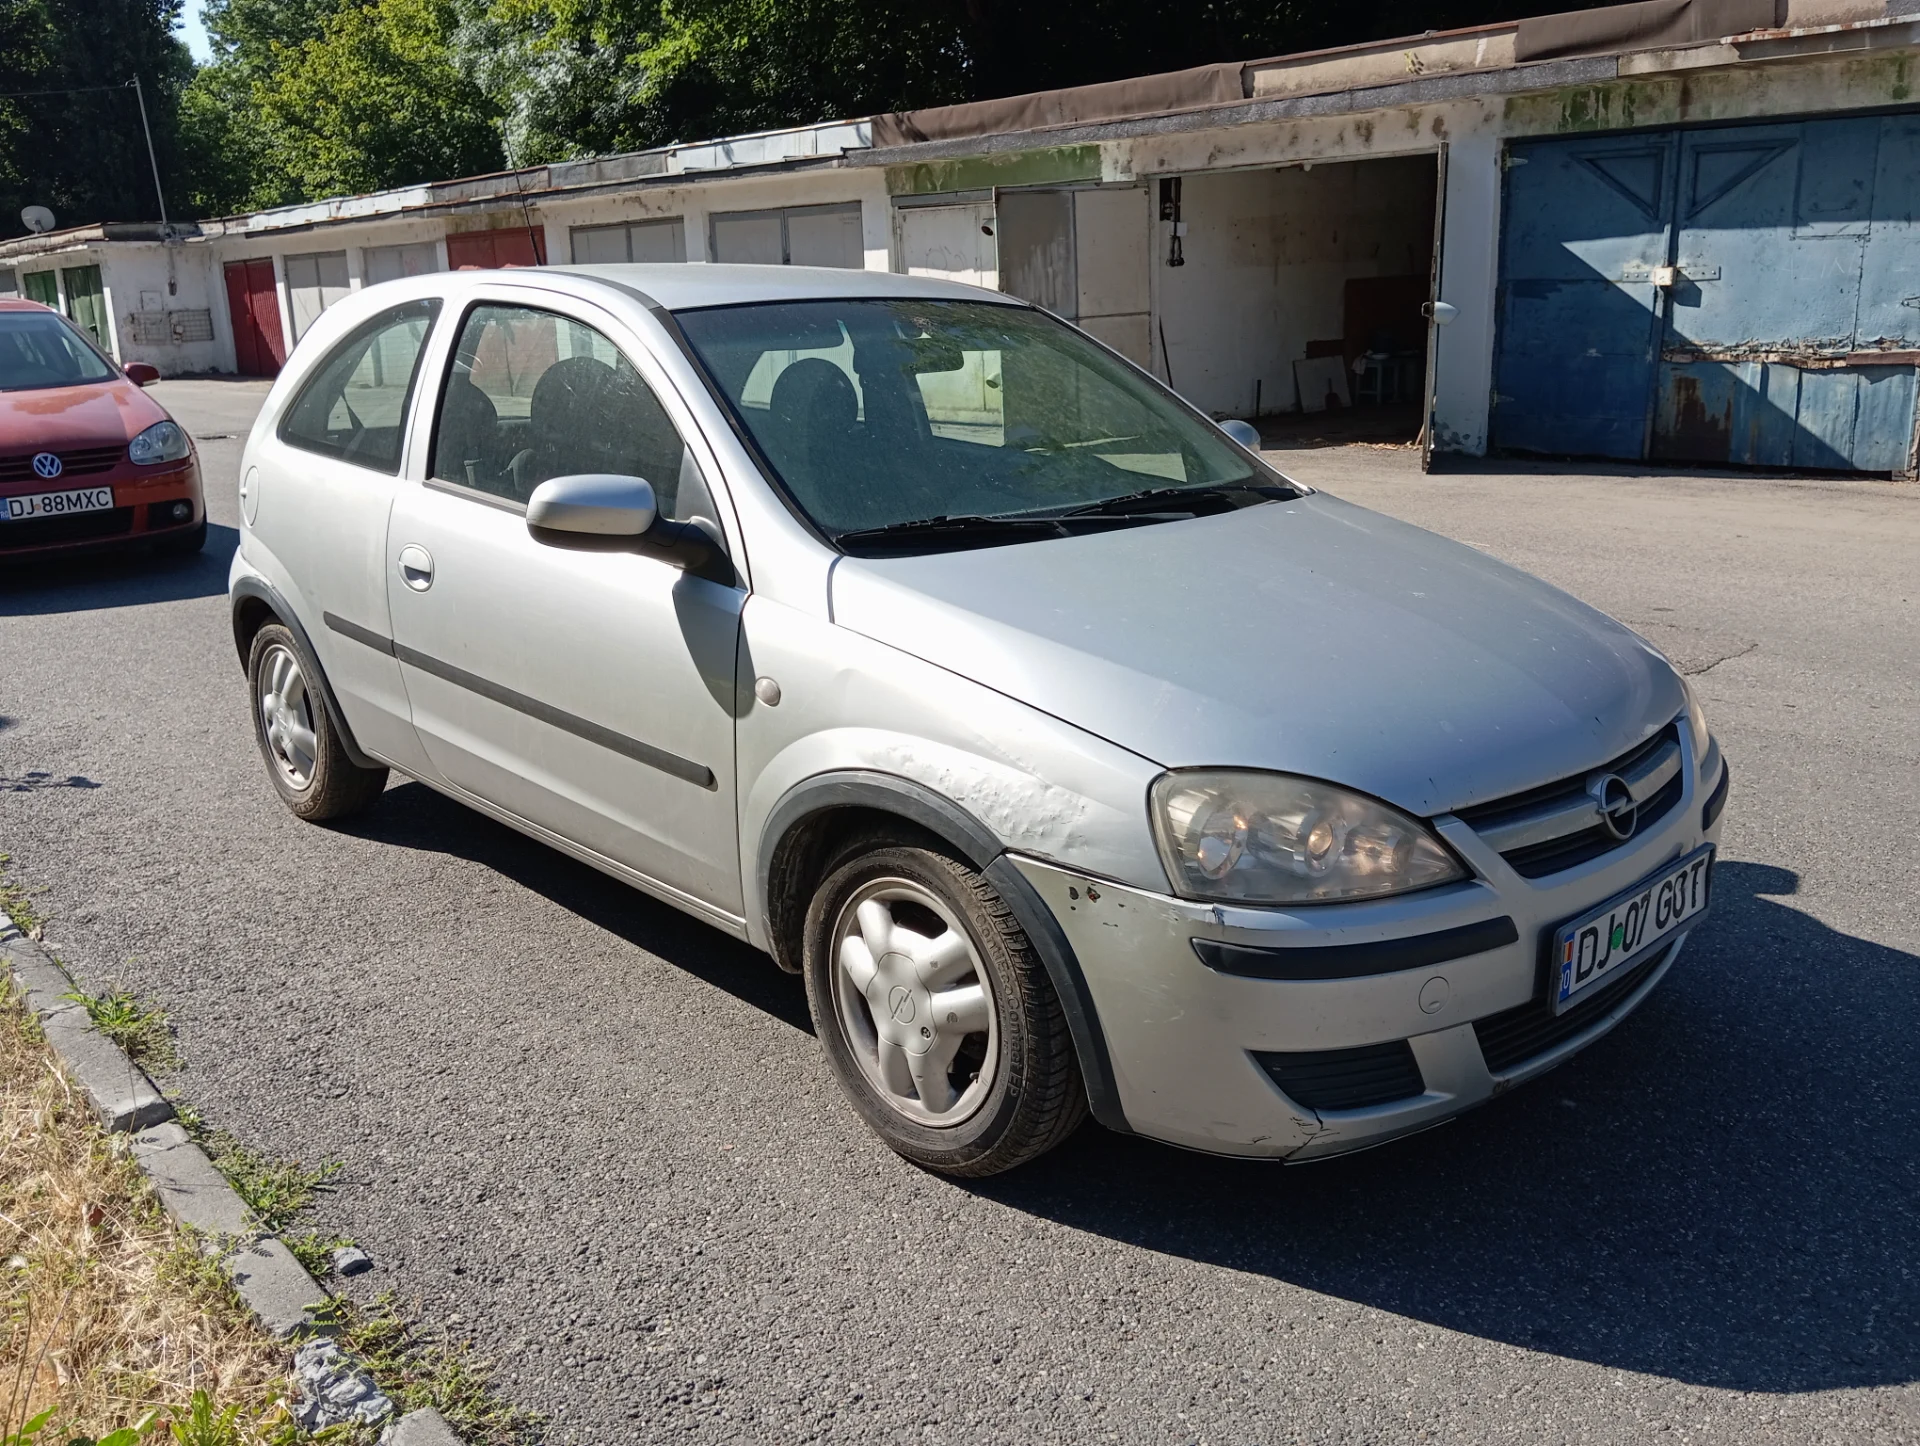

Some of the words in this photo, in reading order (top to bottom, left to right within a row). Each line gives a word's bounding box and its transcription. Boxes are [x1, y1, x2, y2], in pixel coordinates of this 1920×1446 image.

[9, 498, 35, 518] DJ
[1574, 913, 1616, 984] DJ
[1621, 889, 1651, 953] 07
